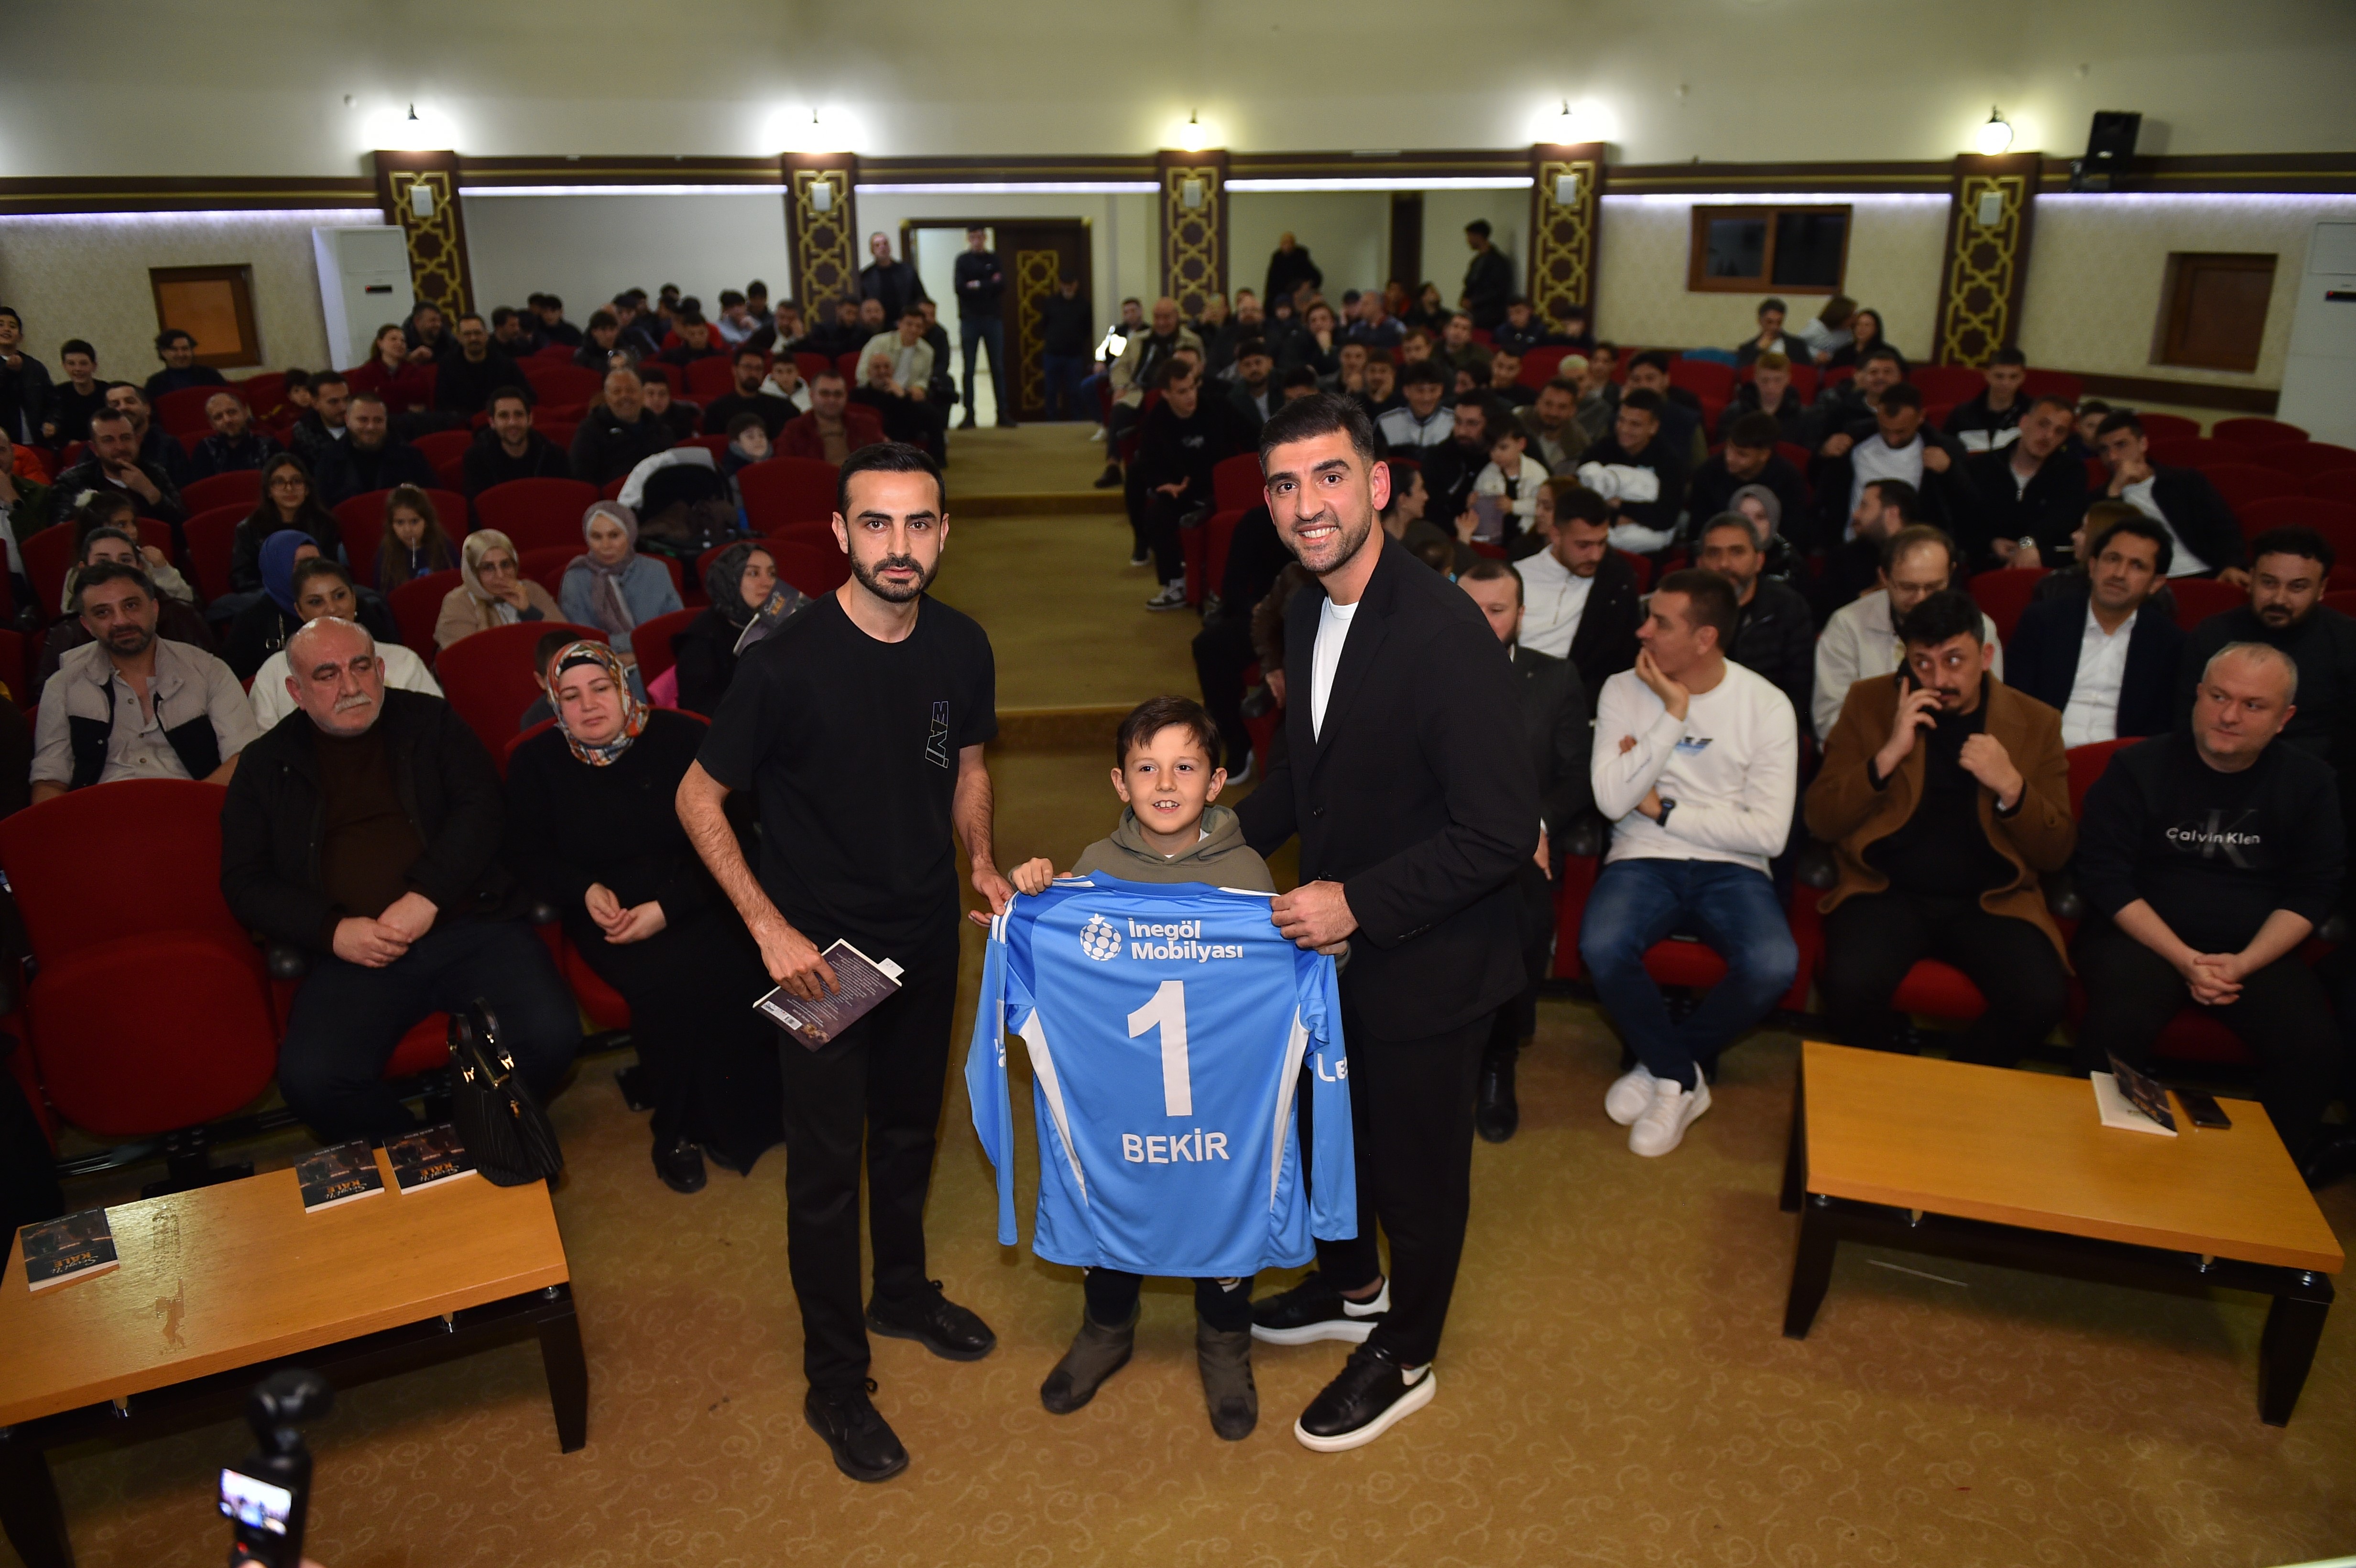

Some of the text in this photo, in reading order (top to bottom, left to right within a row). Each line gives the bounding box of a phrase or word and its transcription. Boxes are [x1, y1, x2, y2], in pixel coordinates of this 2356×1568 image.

[2165, 827, 2223, 843] Calvin
[1127, 917, 1201, 941] İnegöl
[1131, 940, 1243, 963] Mobilyası
[1127, 980, 1192, 1116] 1
[1122, 1128, 1230, 1164] BEKİR
[54, 1251, 91, 1268] KALE
